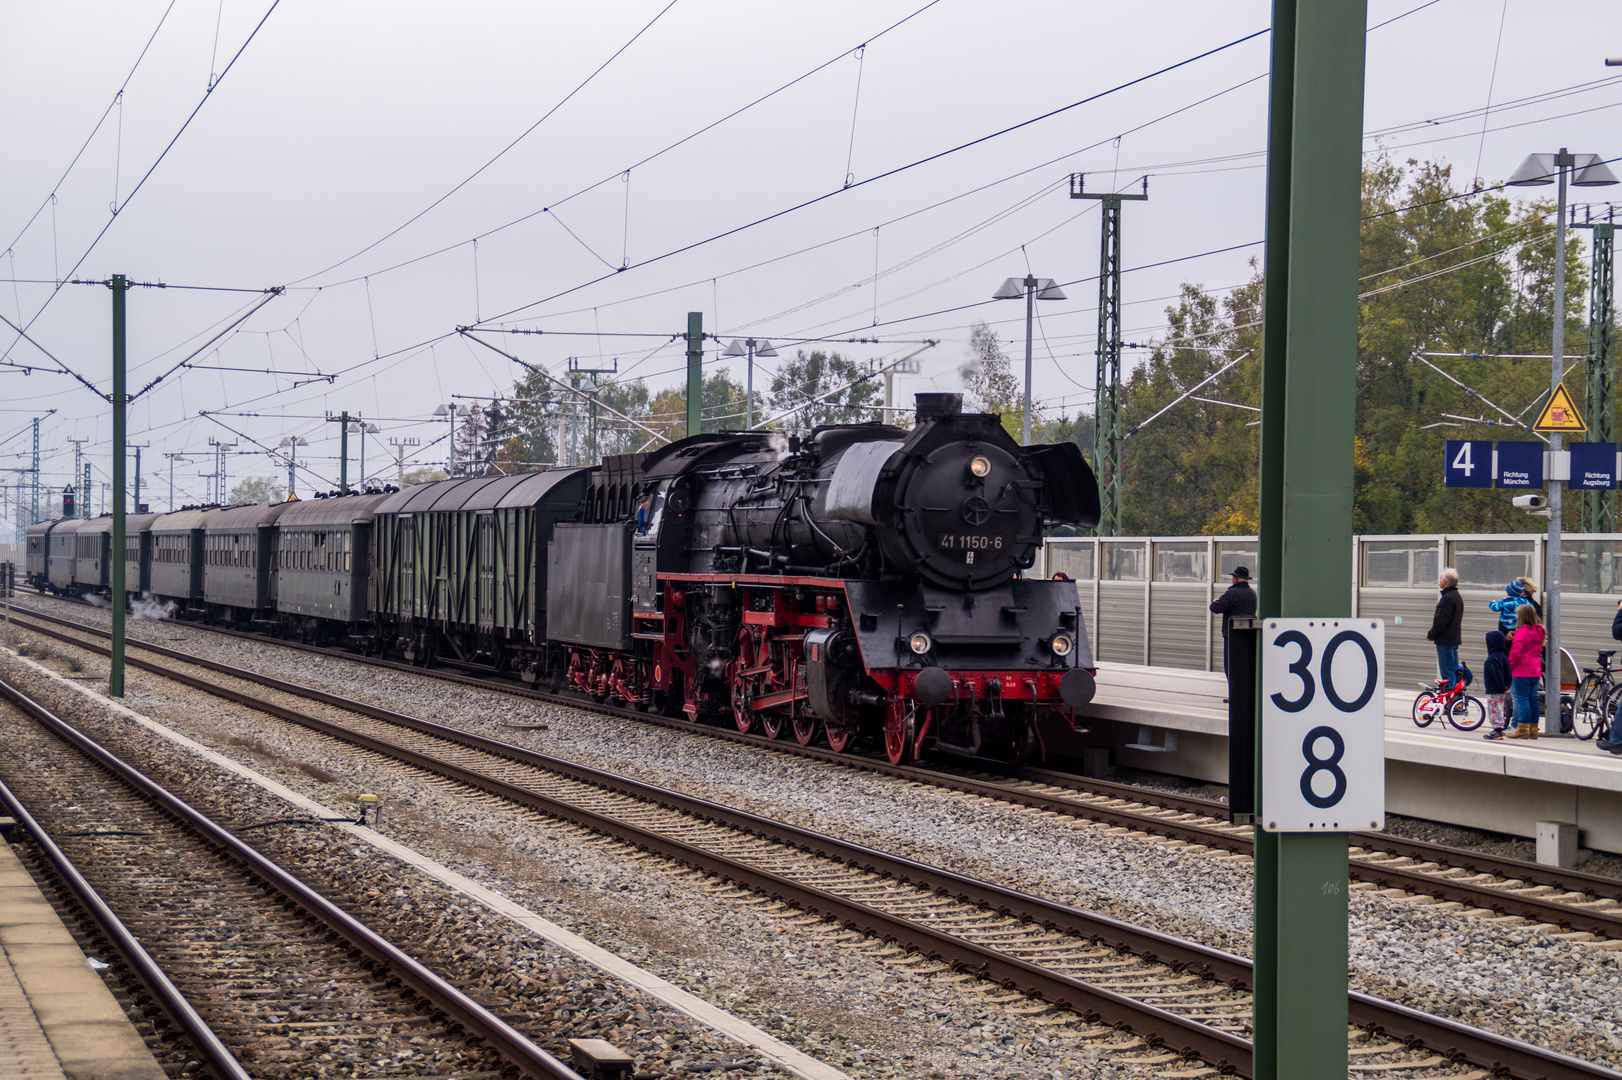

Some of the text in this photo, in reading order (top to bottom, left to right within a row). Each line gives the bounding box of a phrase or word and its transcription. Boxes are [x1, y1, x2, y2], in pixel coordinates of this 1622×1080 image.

[1452, 442, 1474, 476] 4
[1503, 471, 1528, 479] Richtung
[1585, 472, 1610, 480] Richtung
[1583, 479, 1610, 487] Augsburg
[941, 535, 1003, 549] 41 1150-6
[1270, 630, 1379, 713] 30
[1300, 725, 1347, 809] 8
